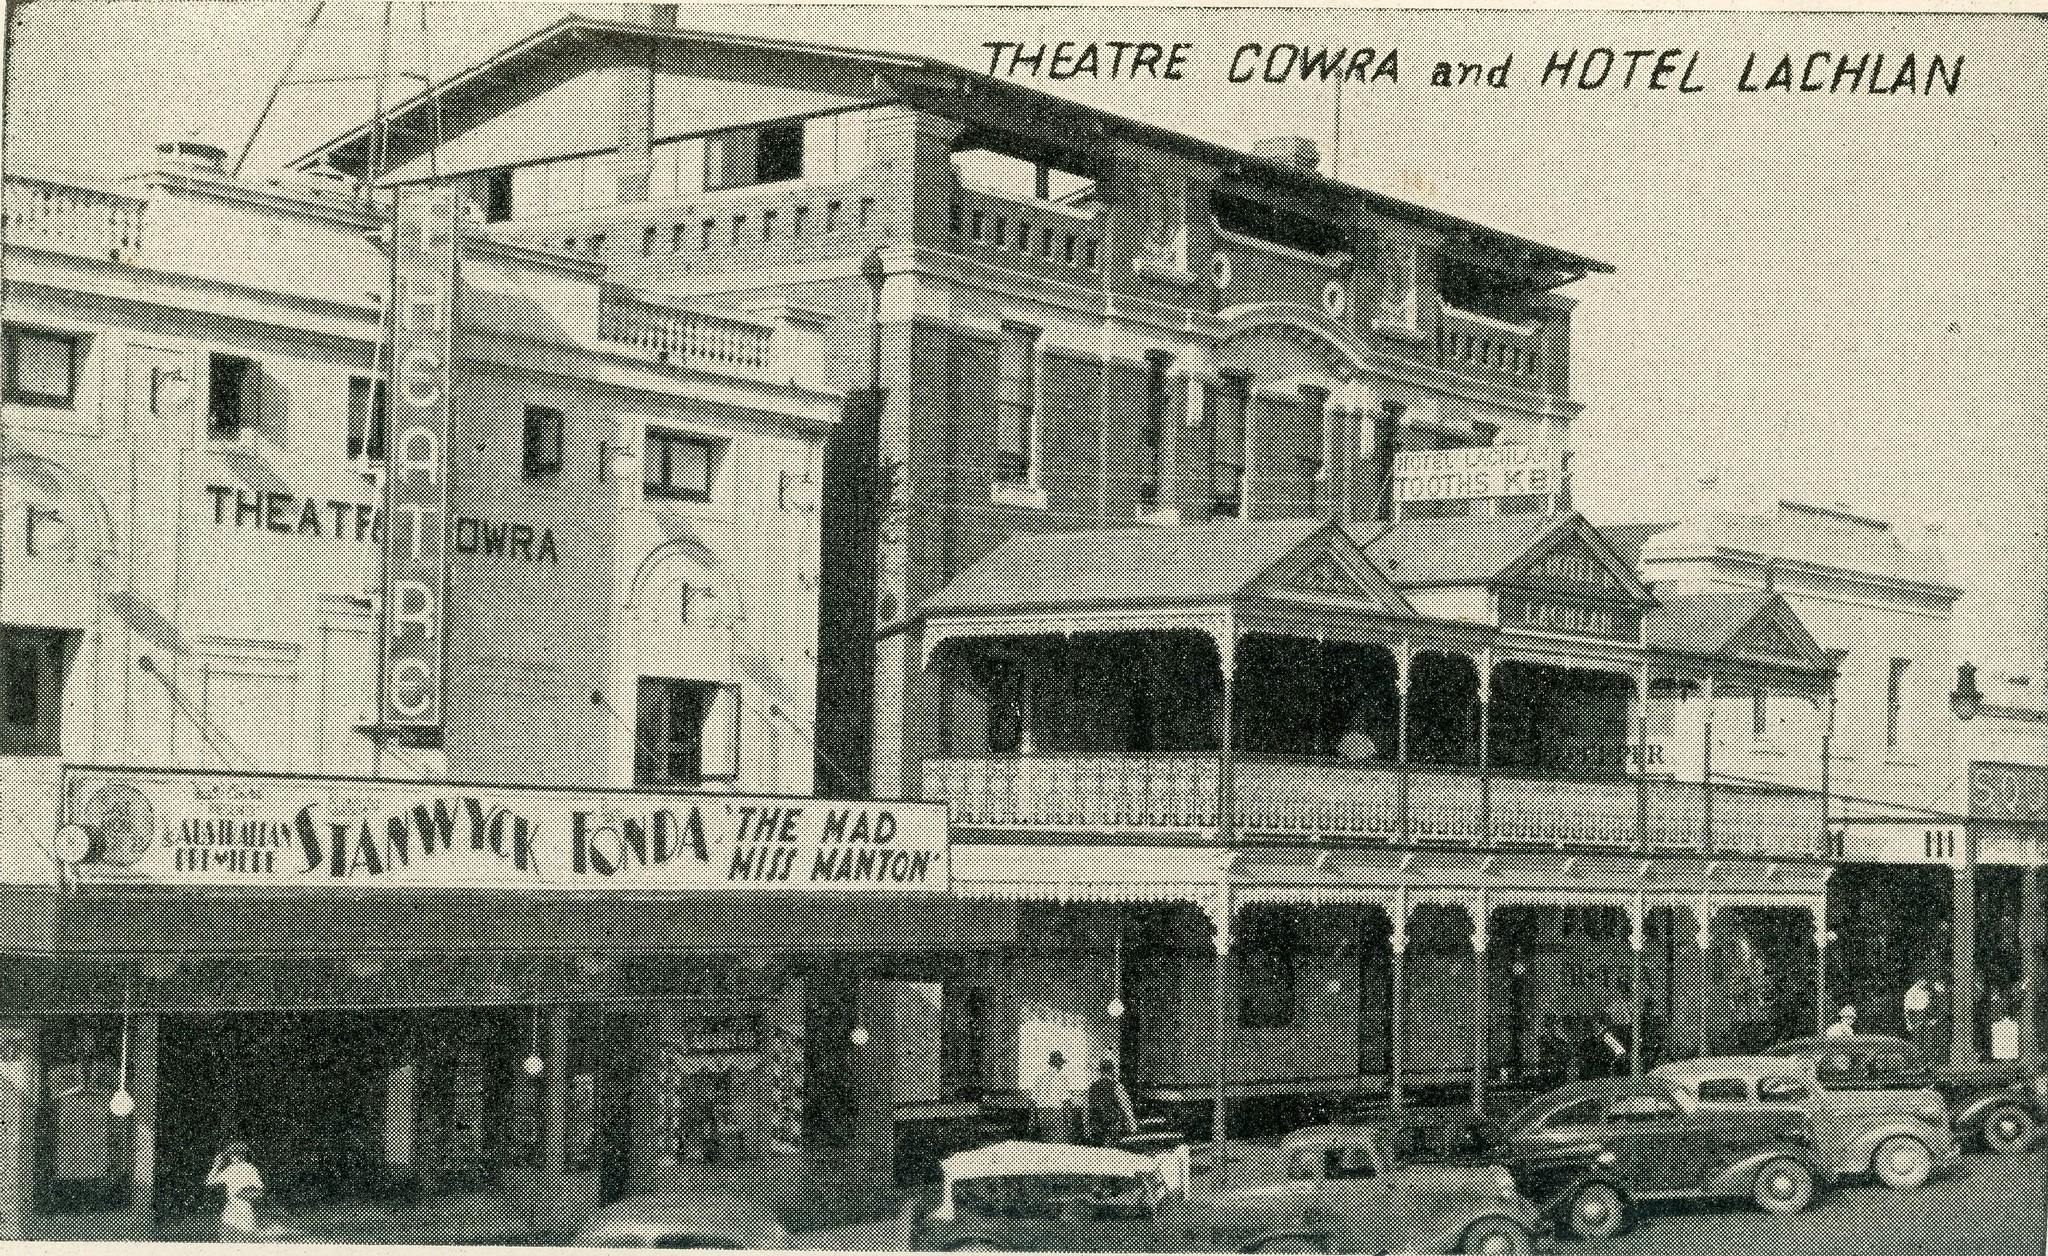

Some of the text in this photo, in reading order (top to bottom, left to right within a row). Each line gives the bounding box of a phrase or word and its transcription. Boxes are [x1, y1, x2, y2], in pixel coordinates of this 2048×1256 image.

[1397, 451, 1454, 472] HOTEL
[1396, 468, 1548, 499] TOOTHS KB
[205, 483, 560, 567] THEATR OWRA
[295, 795, 710, 878] STANWYCK FONDA
[820, 808, 899, 846] MAD
[728, 846, 799, 882] MISS
